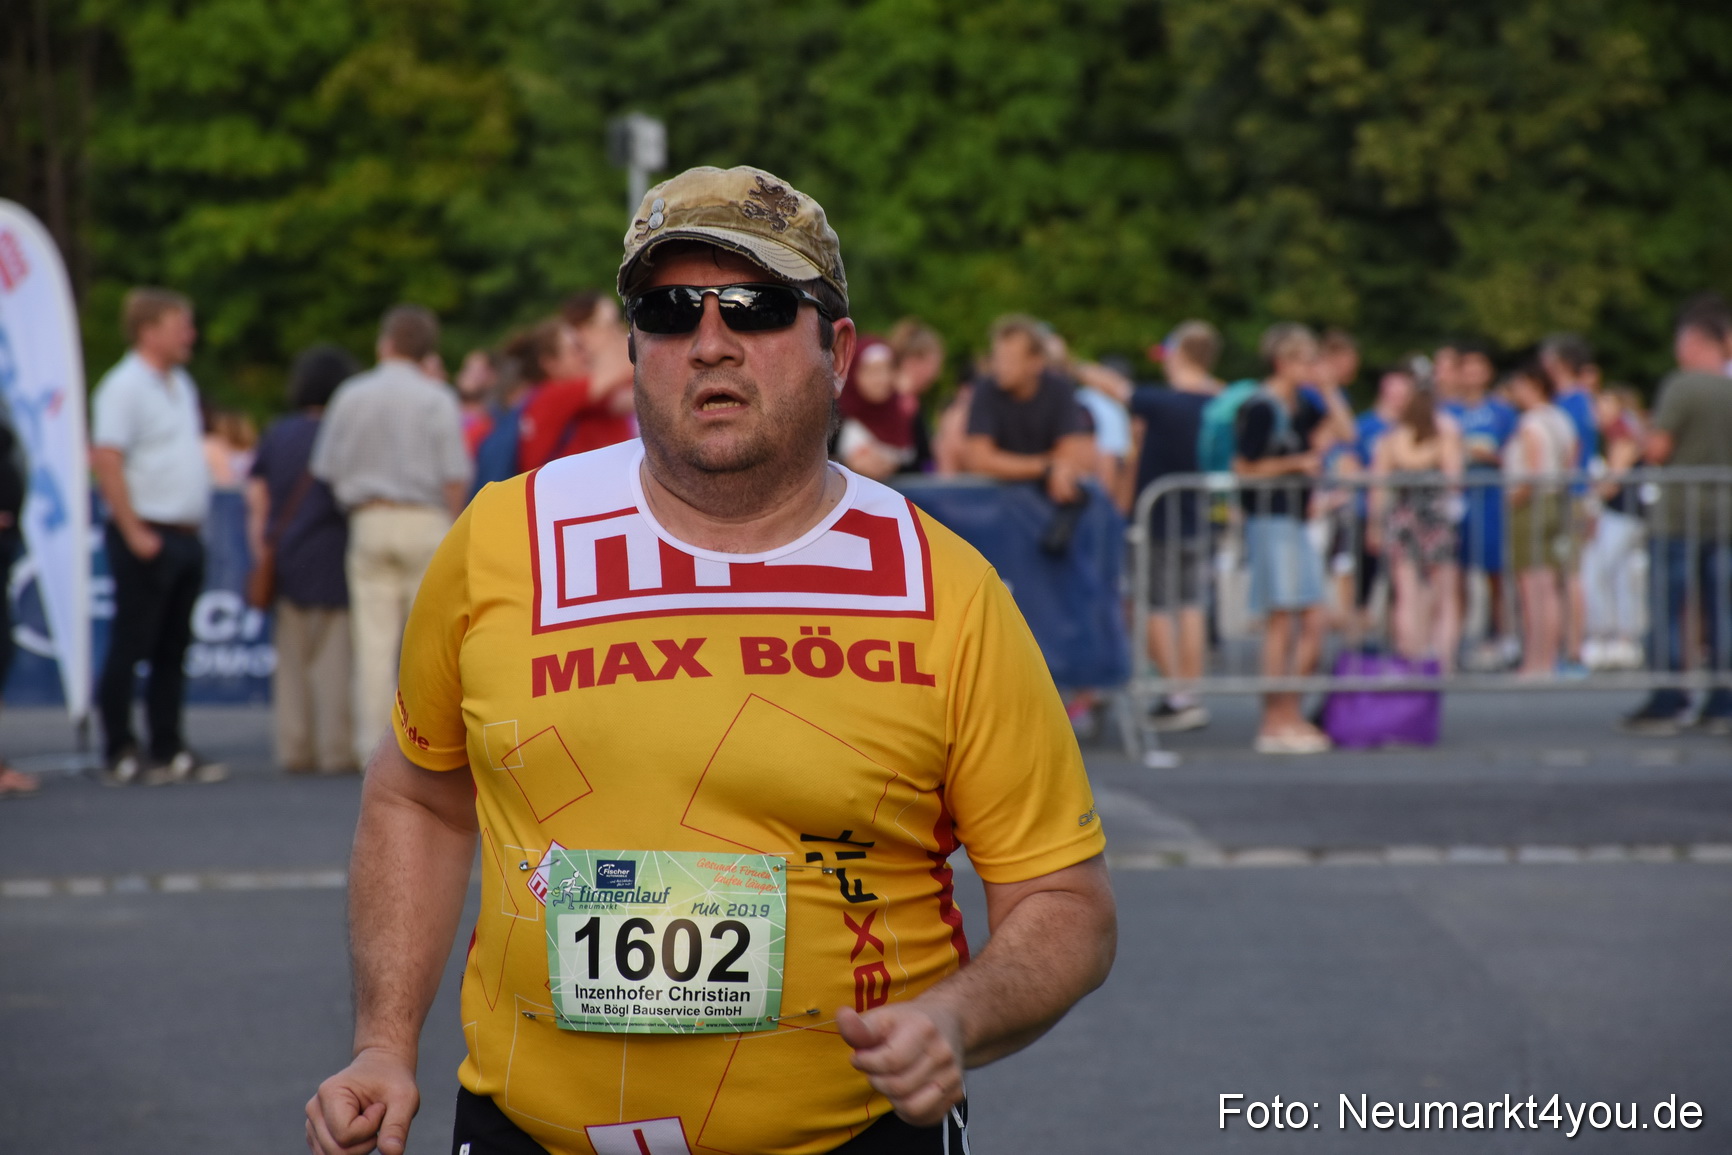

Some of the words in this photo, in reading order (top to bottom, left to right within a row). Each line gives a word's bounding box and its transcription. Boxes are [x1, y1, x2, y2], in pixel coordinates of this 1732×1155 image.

[531, 637, 713, 698] MAX
[739, 626, 936, 687] BÖGL
[696, 857, 738, 873] Gesunde
[739, 865, 772, 880] Firmen
[713, 872, 743, 887] laufen
[580, 885, 672, 904] firmenlauf
[726, 903, 770, 917] 2019
[575, 916, 751, 983] 1602
[575, 984, 663, 1001] Inzenhofer
[668, 986, 750, 1003] Christian
[581, 1003, 602, 1014] Max
[604, 1003, 629, 1018] Bögl
[632, 1004, 701, 1016] Bauservice
[704, 1005, 742, 1016] GmbH
